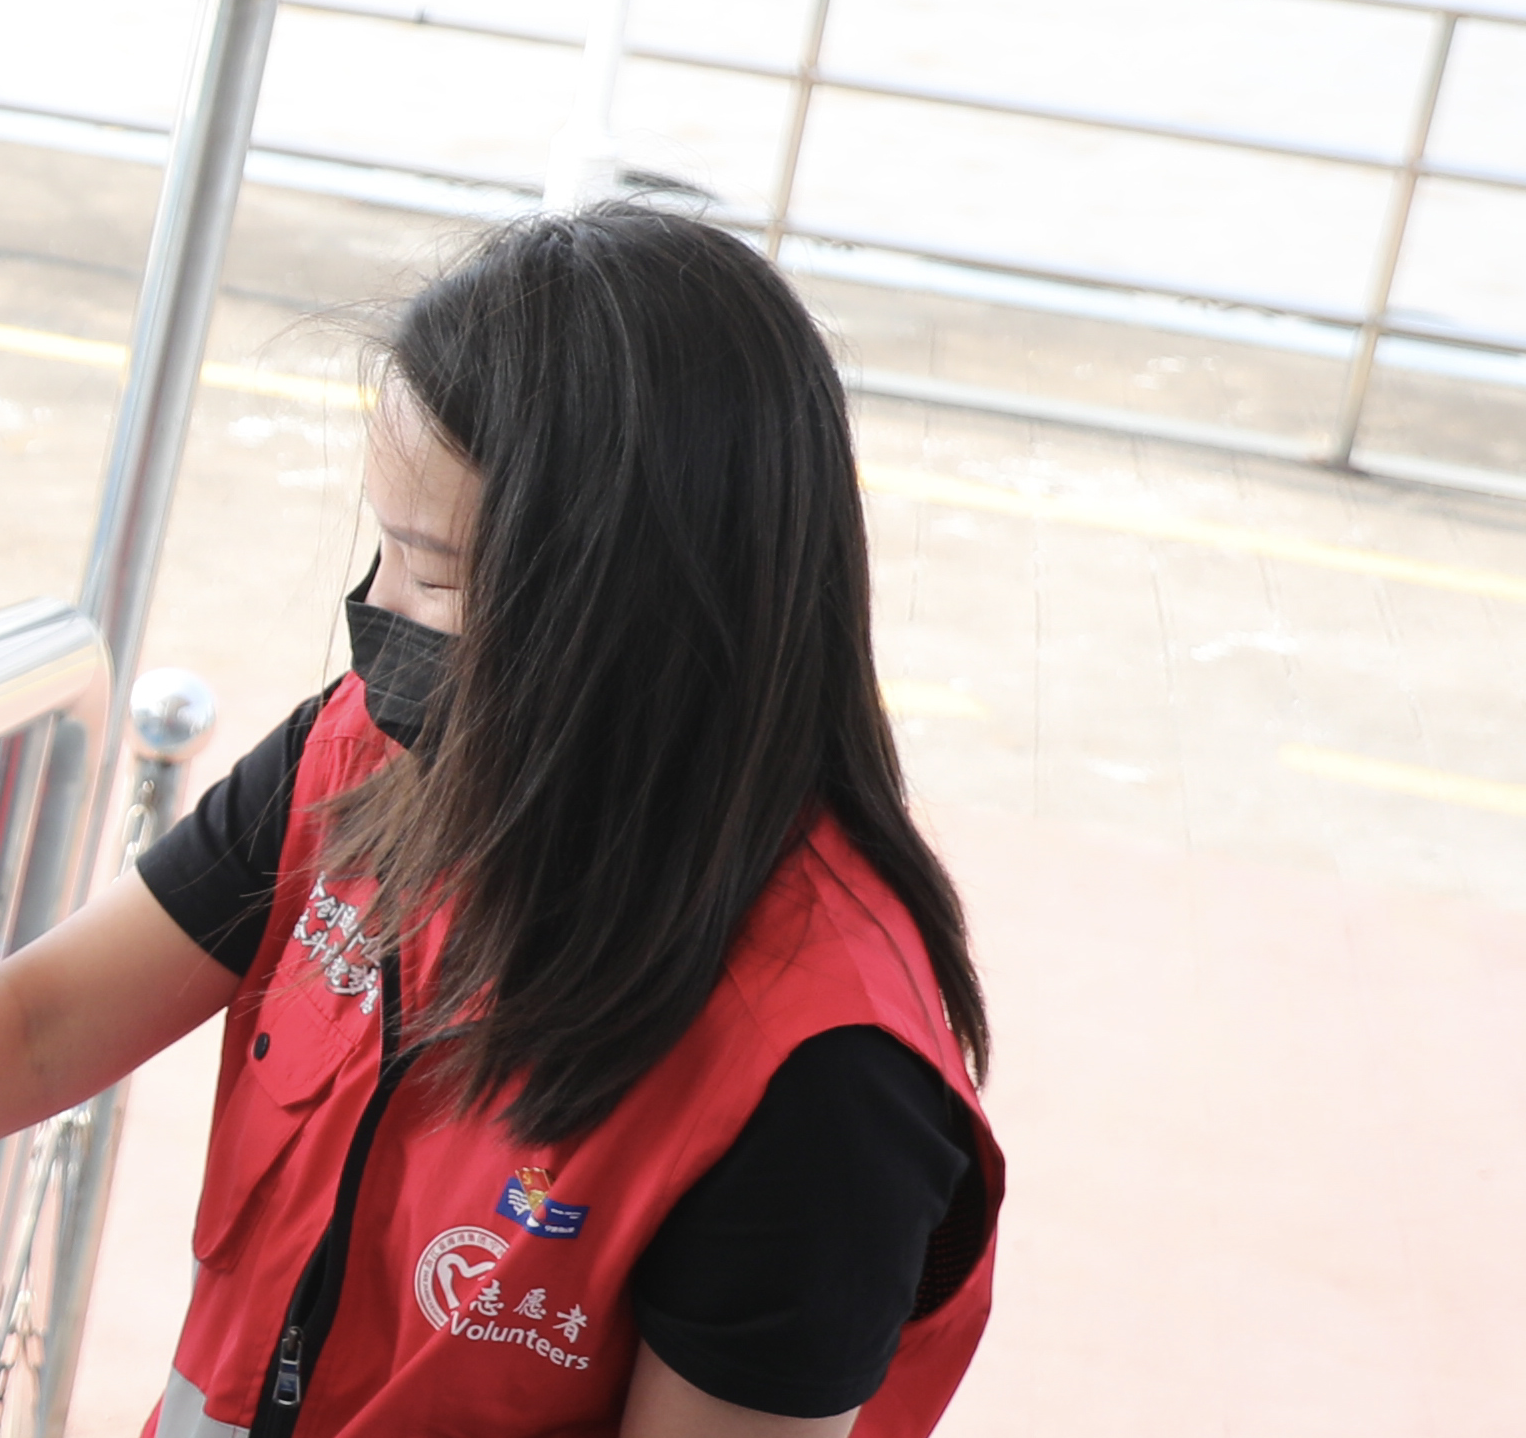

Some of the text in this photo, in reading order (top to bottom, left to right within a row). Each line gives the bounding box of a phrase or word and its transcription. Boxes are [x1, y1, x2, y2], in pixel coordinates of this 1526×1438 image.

[449, 1311, 590, 1371] Volunteers
[469, 1278, 588, 1344] 志愿者
